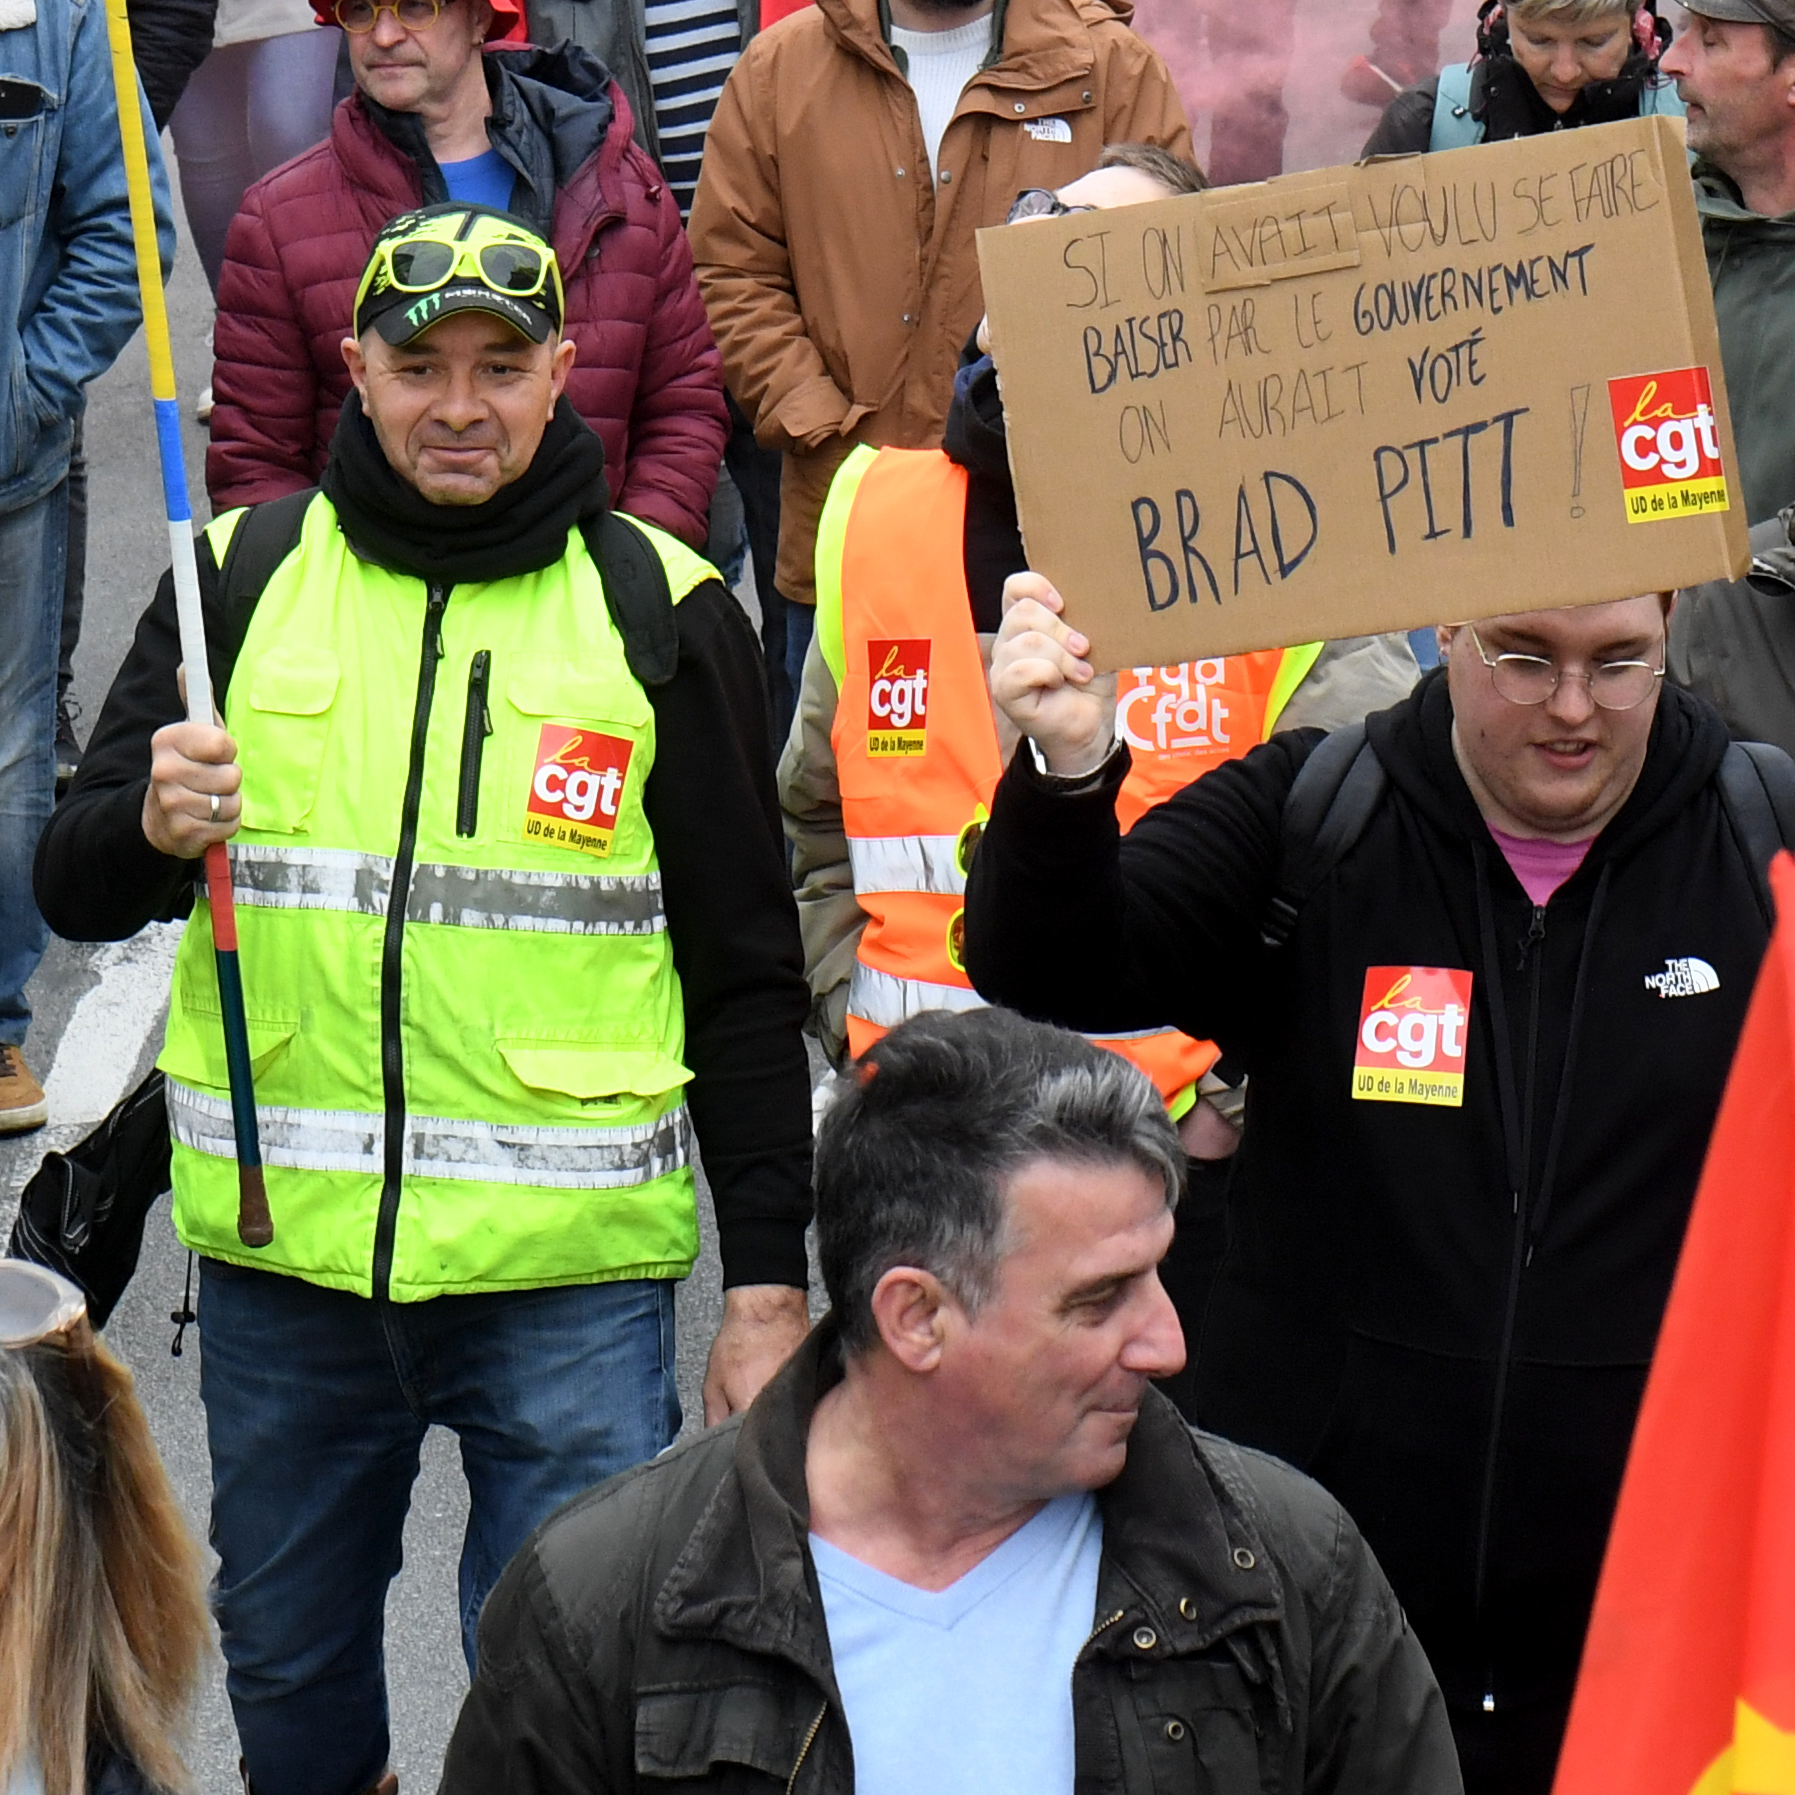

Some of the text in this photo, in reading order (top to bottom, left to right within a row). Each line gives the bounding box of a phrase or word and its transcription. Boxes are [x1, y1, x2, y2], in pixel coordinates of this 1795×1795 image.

[1063, 148, 1661, 309] SI ON AVAIT VOULU SE FAIRE
[1083, 242, 1596, 395] BAISER PAR LE GOUVERNEMENT
[1118, 326, 1488, 464] ON AURAIT VOTÉ
[1620, 403, 1720, 480] cgt
[1130, 383, 1592, 613] BRAD PITT !
[1630, 488, 1726, 515] UD de la Mayenne
[870, 668, 928, 728] cgt
[869, 736, 880, 752] UD
[533, 766, 622, 821] cgt
[526, 818, 608, 851] UD de la Mayenne
[1644, 970, 1693, 990] NORTH
[1660, 983, 1695, 999] FACE
[1664, 958, 1689, 973] THE
[1361, 1003, 1464, 1068] cgt
[1357, 1074, 1458, 1101] UD de la Mayenne
